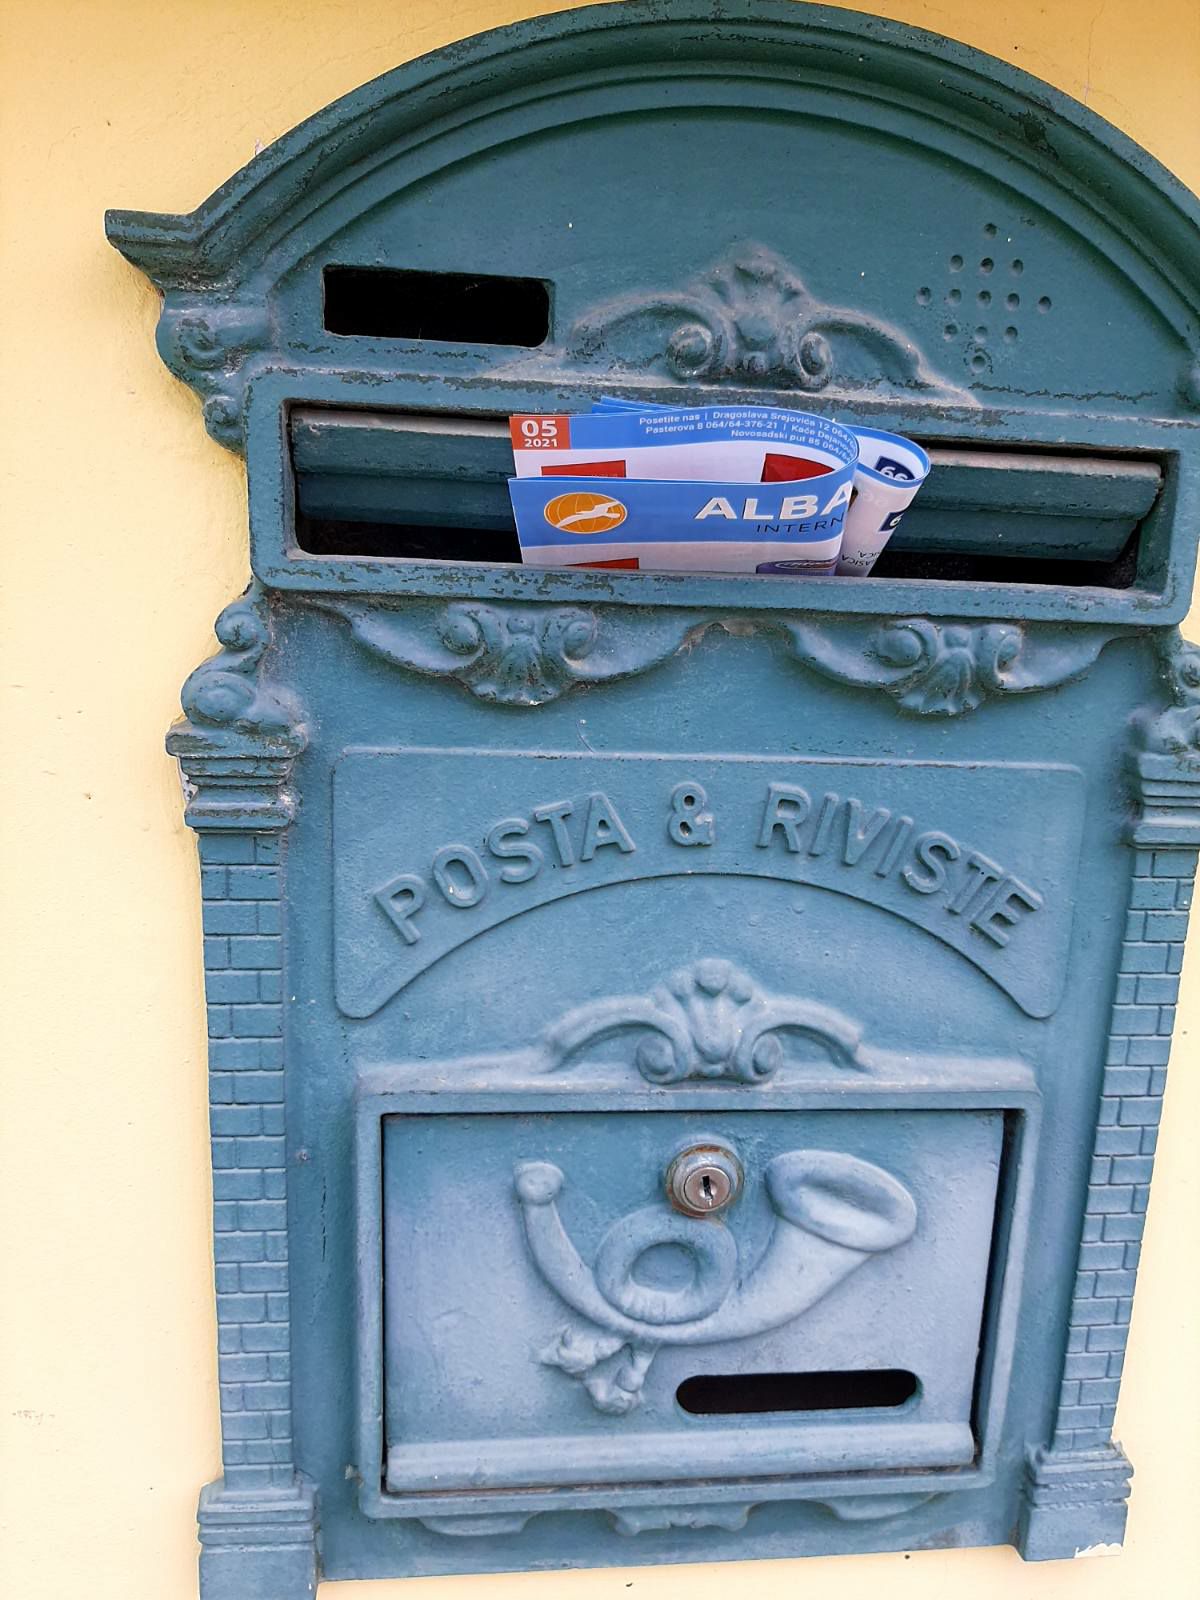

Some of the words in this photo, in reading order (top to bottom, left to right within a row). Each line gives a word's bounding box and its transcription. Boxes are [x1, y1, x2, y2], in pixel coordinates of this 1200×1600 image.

[521, 420, 557, 437] 05
[640, 415, 679, 425] Posetite
[682, 414, 700, 422] nas
[713, 410, 768, 420] Dragoslava
[819, 422, 830, 431] 12
[646, 423, 694, 434] Pasterova
[525, 439, 558, 447] 2021
[731, 430, 787, 439] Novosadski
[790, 433, 805, 443] put
[757, 516, 844, 533] INTERN
[372, 791, 637, 945] POSTA
[668, 780, 716, 848] &
[755, 781, 1045, 950] RIVISTE
